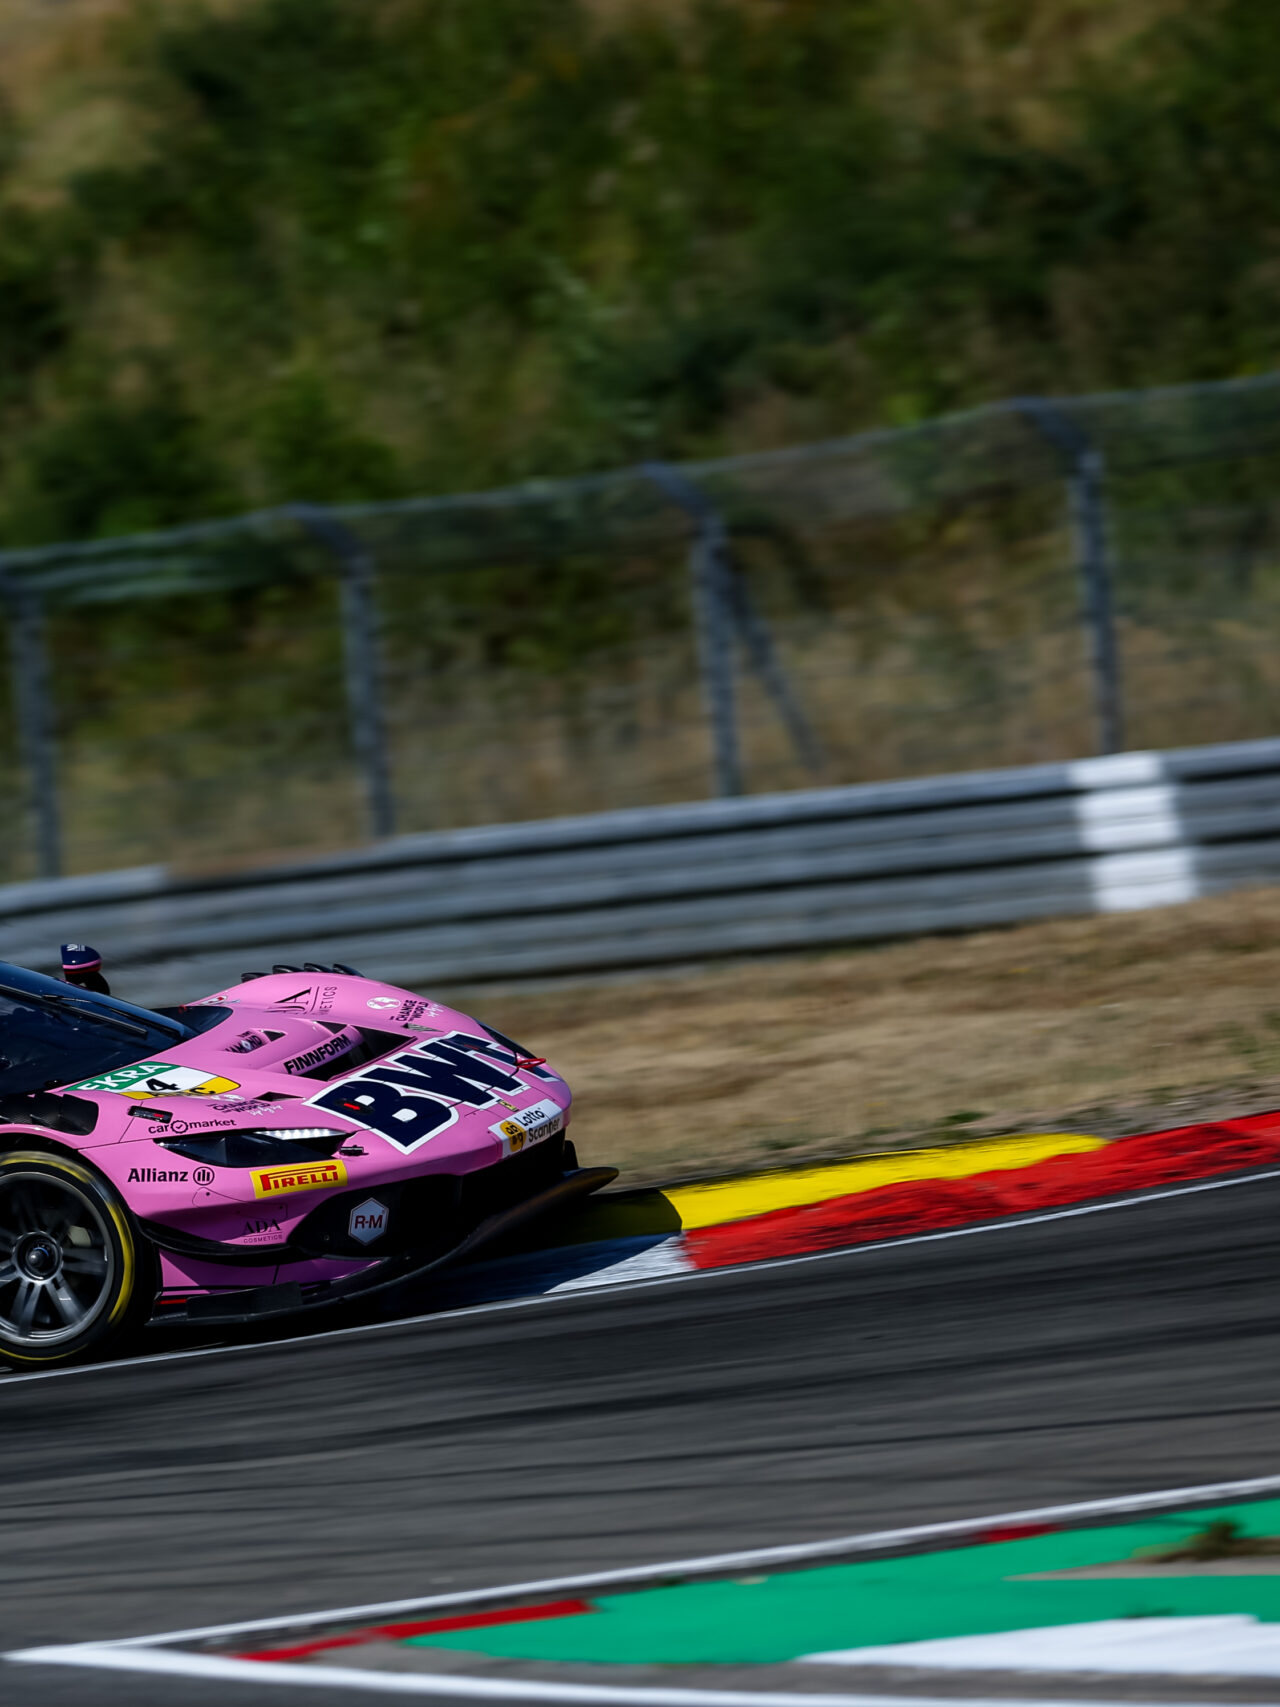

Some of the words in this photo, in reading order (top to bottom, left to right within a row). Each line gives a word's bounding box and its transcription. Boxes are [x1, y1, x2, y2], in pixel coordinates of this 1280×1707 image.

[283, 1034, 353, 1075] FINNFORM
[303, 1030, 563, 1155] BWT
[190, 1119, 237, 1130] market
[514, 1106, 546, 1127] Lotto
[528, 1118, 561, 1143] Scanner
[127, 1168, 189, 1183] Allianz
[259, 1165, 339, 1192] PIRELLI
[242, 1218, 281, 1235] ADA
[353, 1214, 384, 1229] R-M
[243, 1234, 283, 1244] COSMETICS
